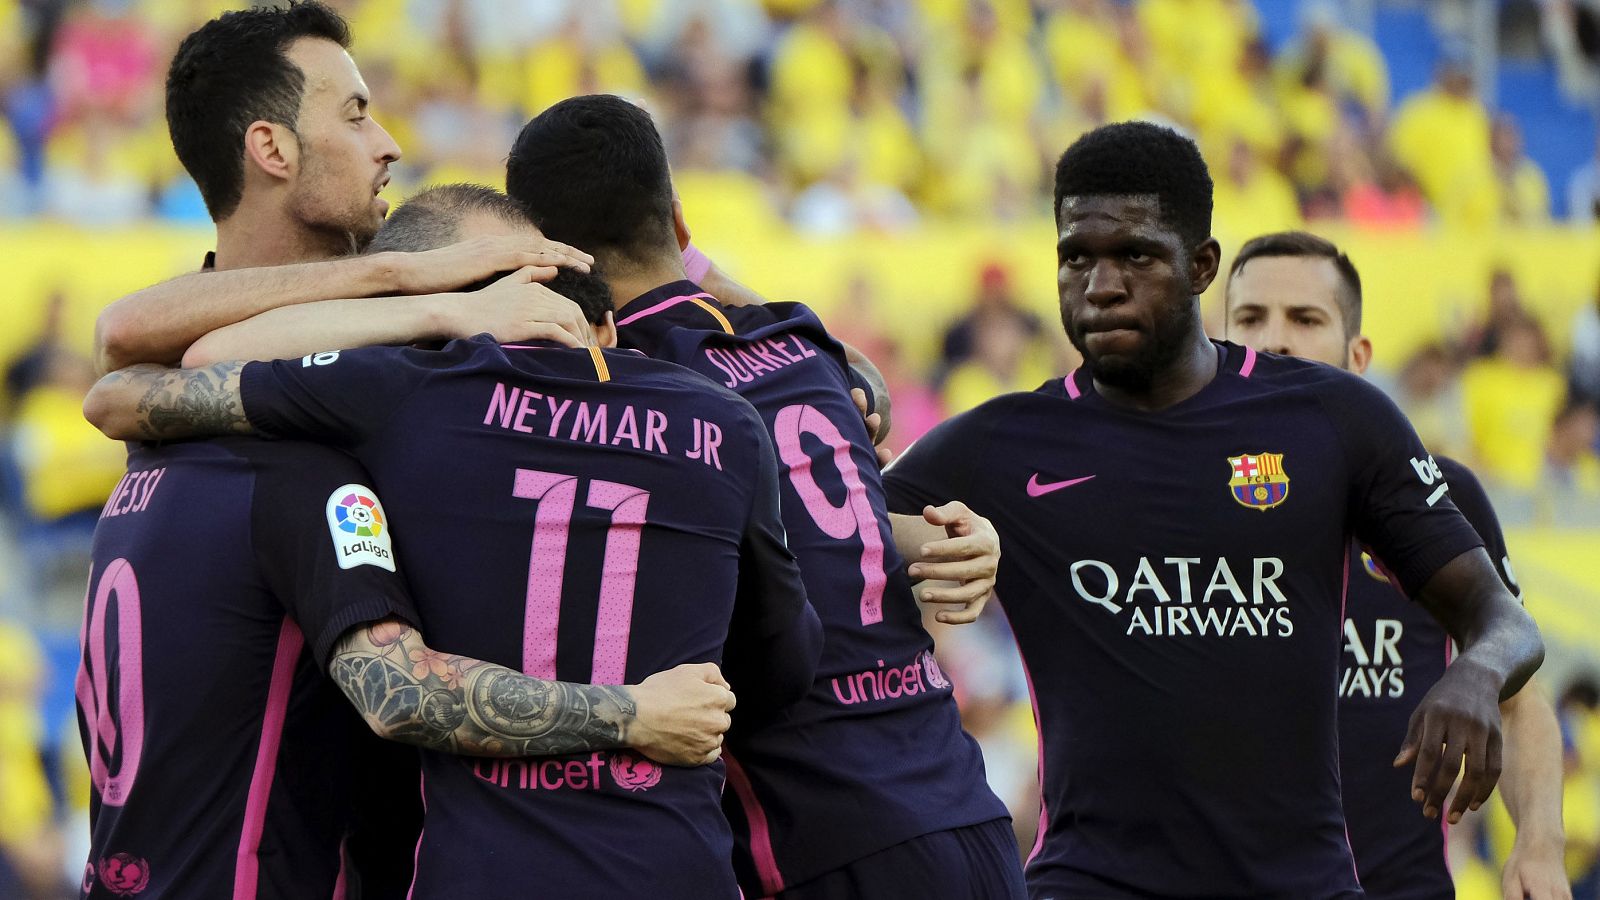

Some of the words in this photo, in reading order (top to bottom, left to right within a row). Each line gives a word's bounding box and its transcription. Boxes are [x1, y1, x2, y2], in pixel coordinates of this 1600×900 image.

[483, 382, 668, 455] NEYMAR
[685, 418, 723, 472] JR
[774, 404, 887, 626] 9
[343, 540, 389, 559] LaLiga
[512, 468, 651, 686] 11
[1069, 556, 1288, 615] QATAR
[1126, 606, 1294, 637] AIRWAYS
[831, 651, 927, 705] unicef
[474, 751, 606, 791] unicef
